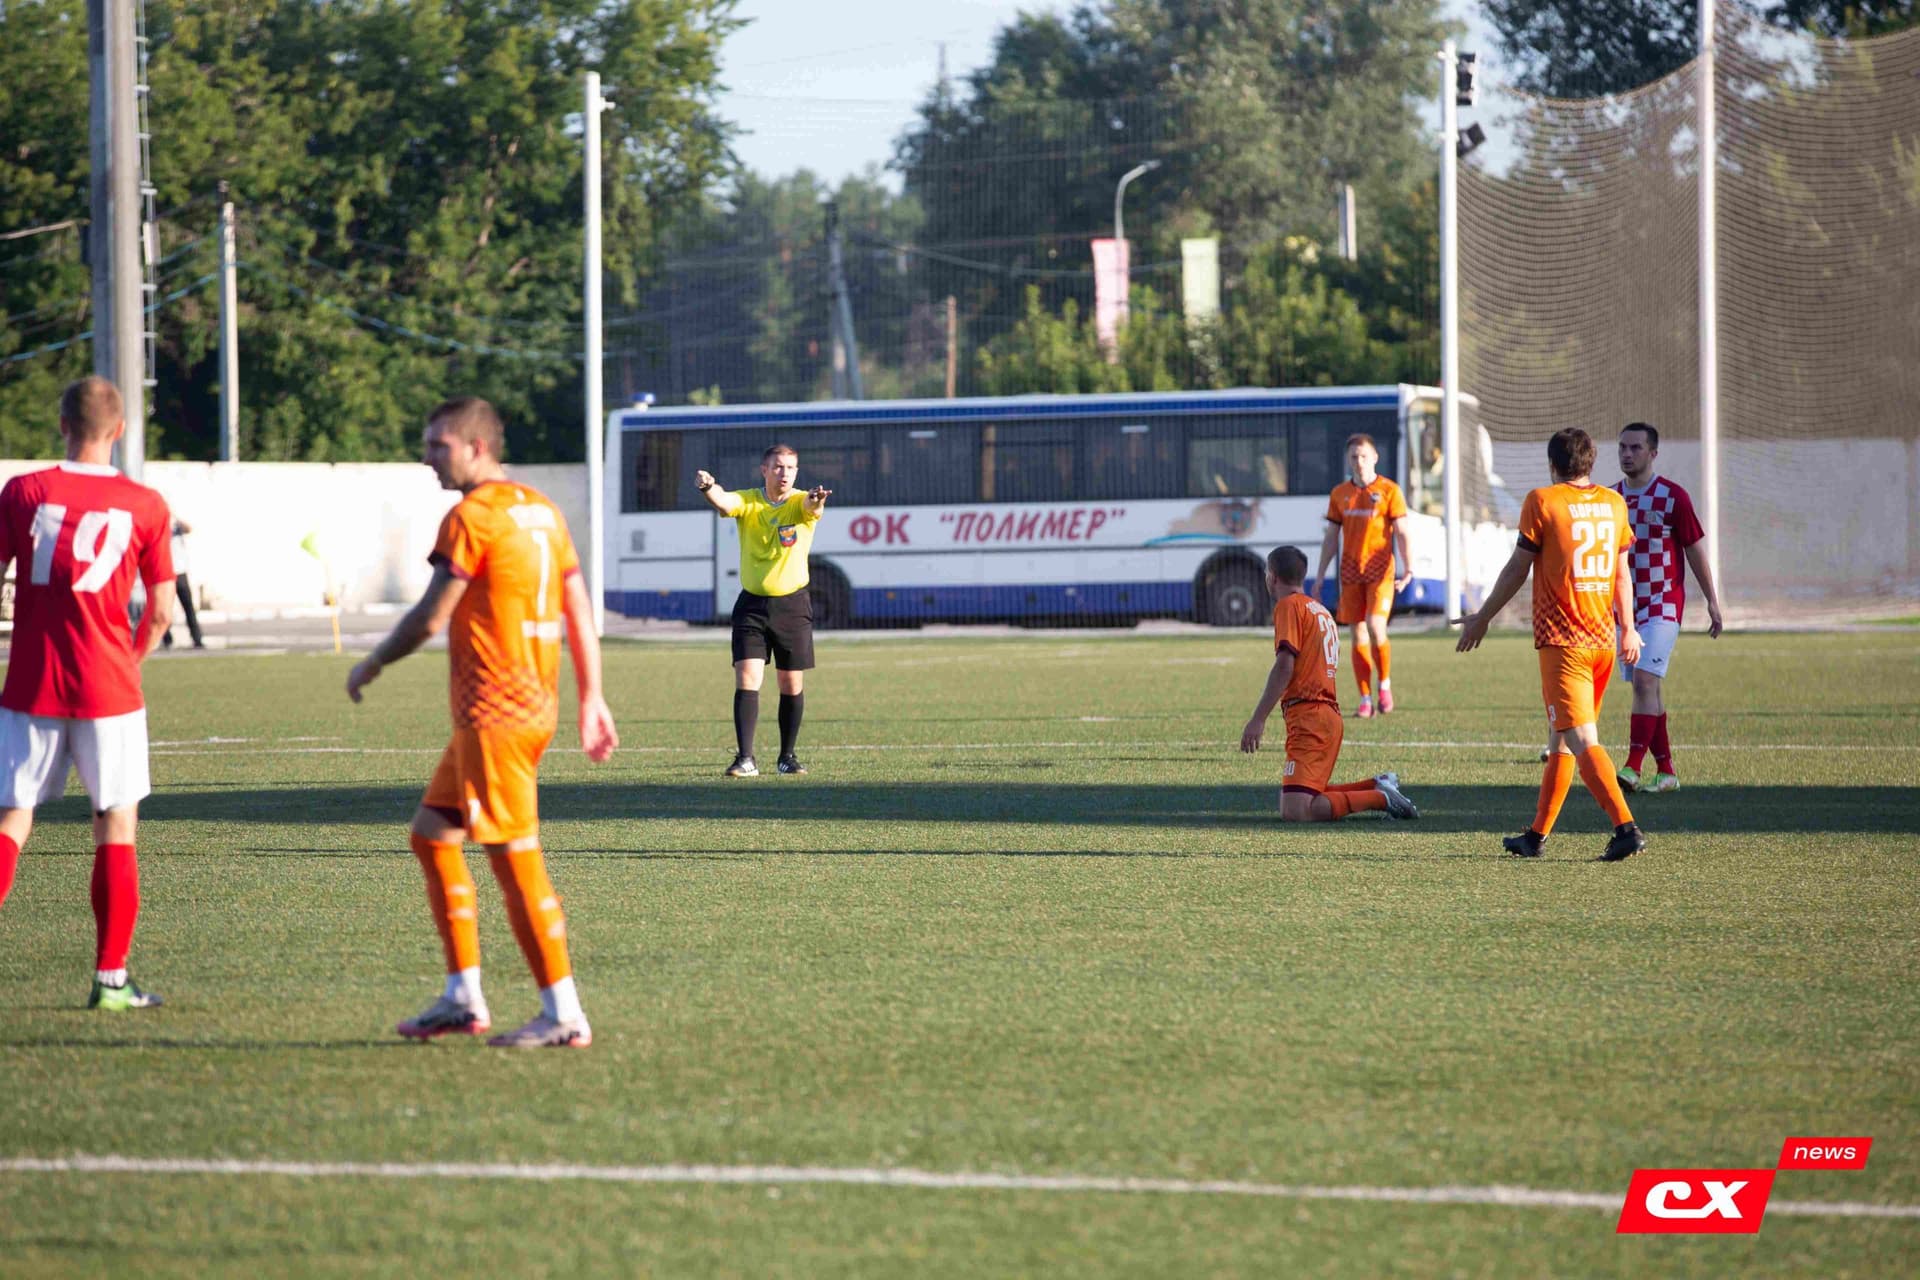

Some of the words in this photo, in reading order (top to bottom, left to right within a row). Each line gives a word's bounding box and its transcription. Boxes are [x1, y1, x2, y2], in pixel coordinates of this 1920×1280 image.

[29, 503, 132, 594] 19
[849, 513, 911, 545] ФК
[939, 508, 1126, 542] “ПОЛИМЕР”
[1571, 521, 1615, 578] 23
